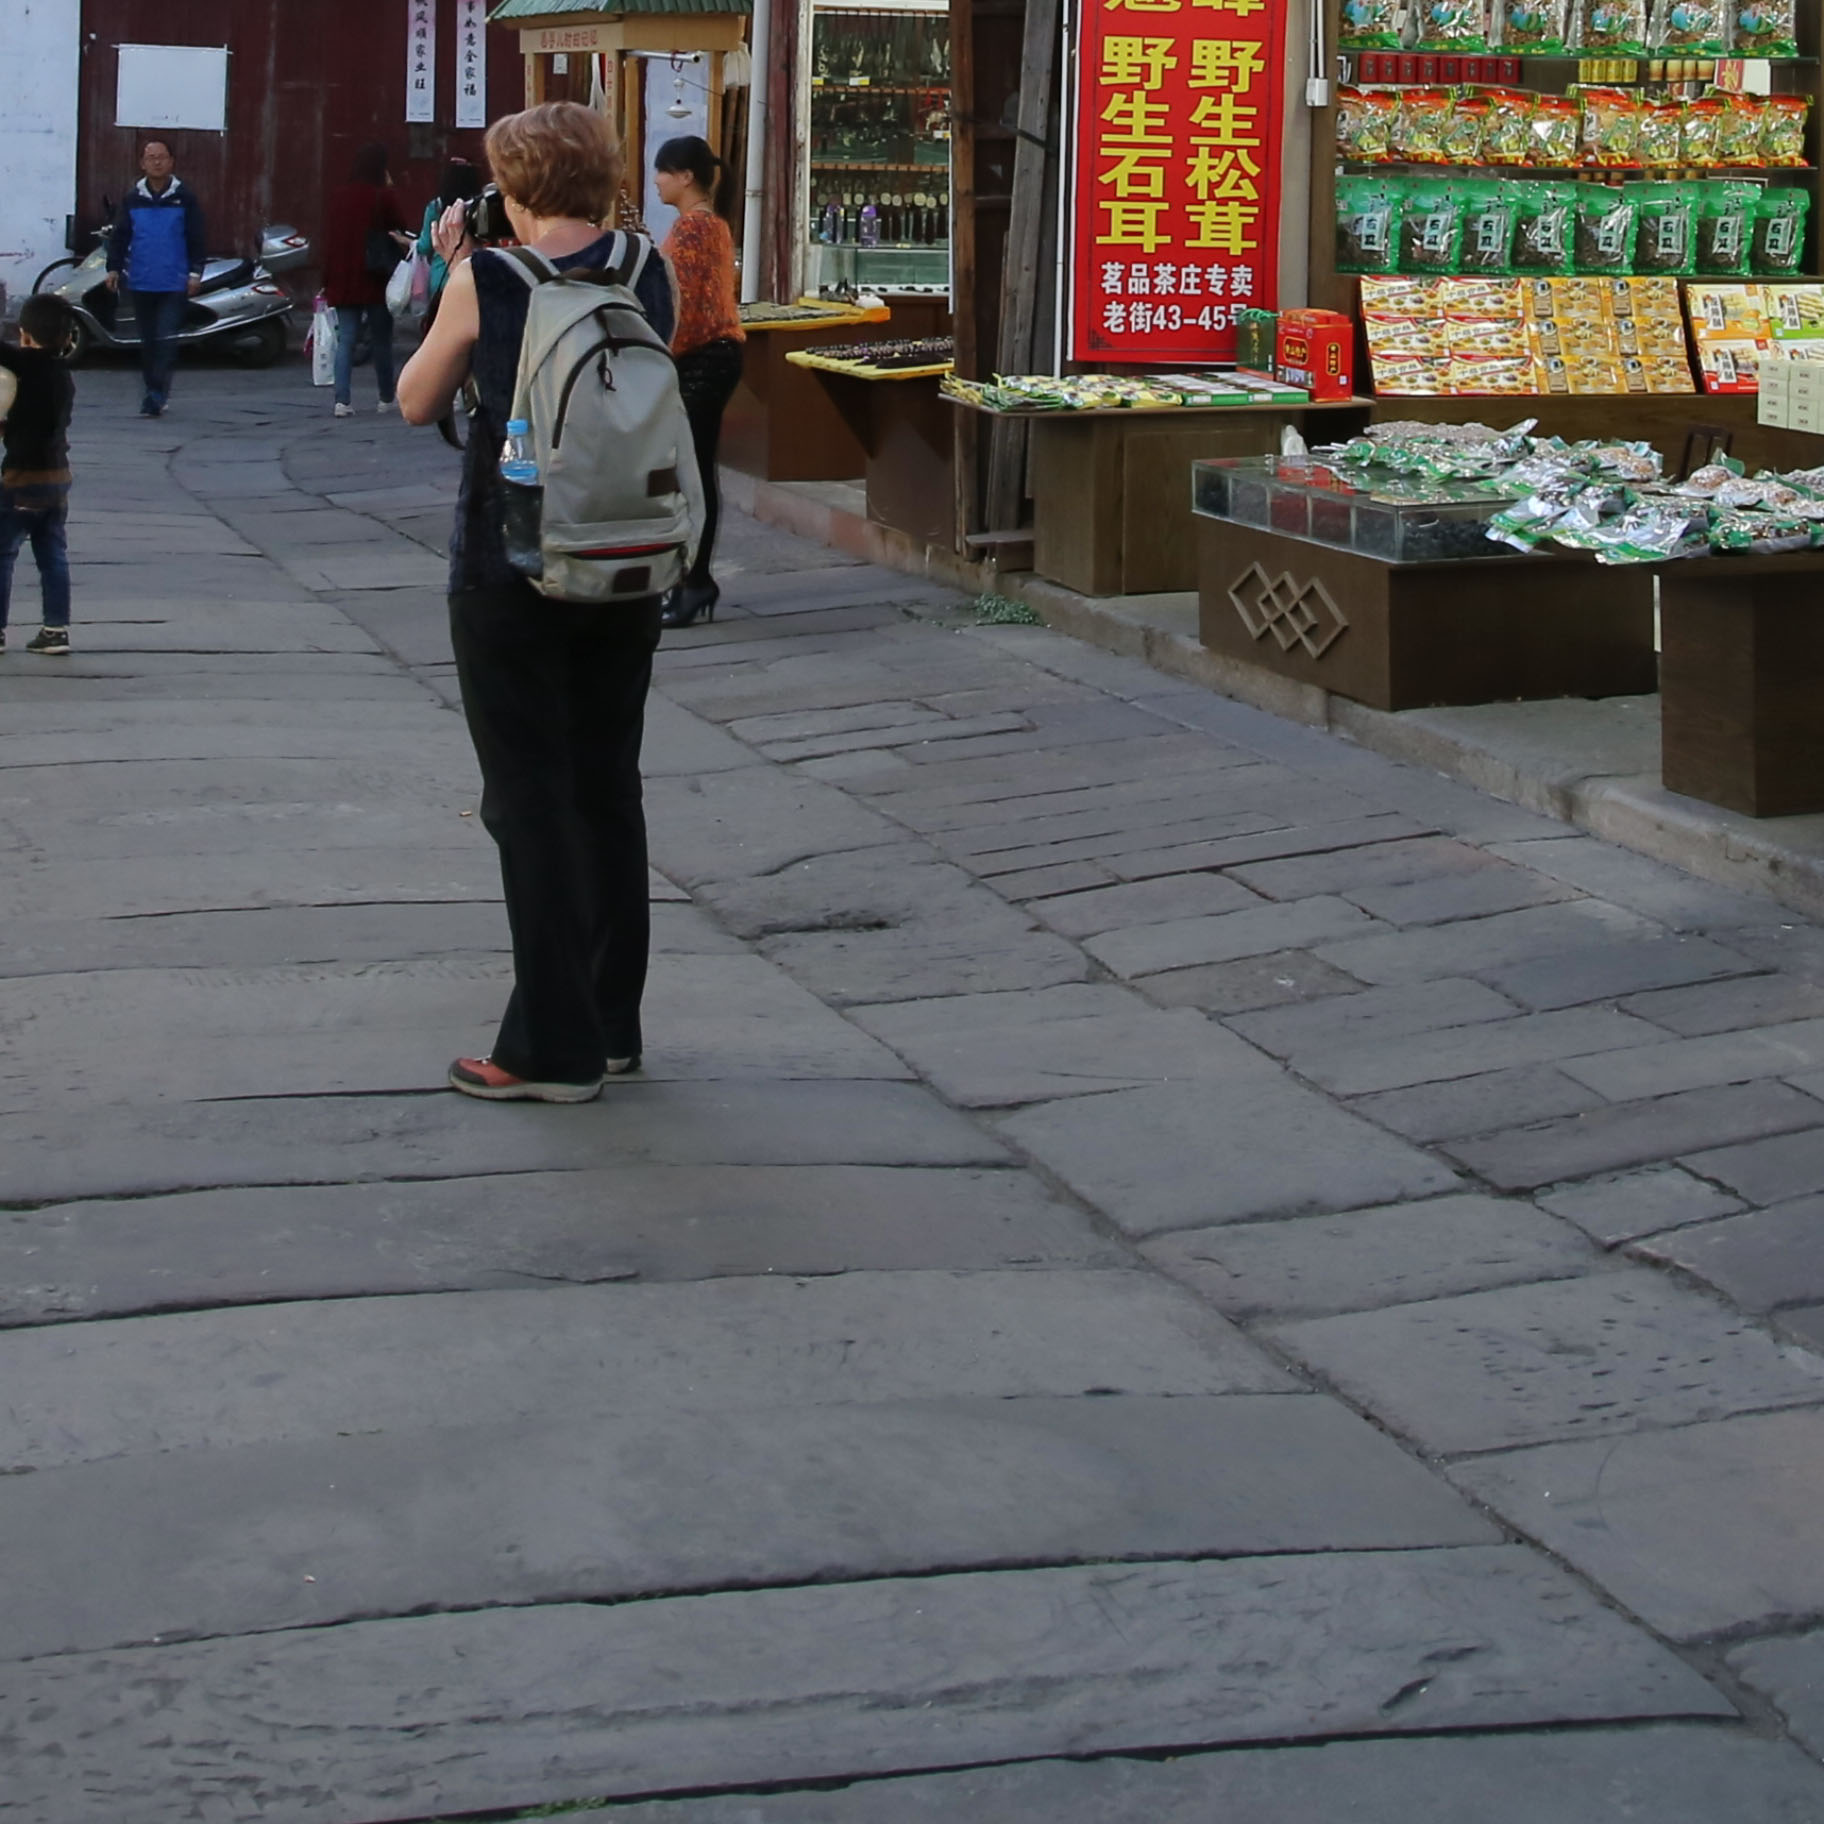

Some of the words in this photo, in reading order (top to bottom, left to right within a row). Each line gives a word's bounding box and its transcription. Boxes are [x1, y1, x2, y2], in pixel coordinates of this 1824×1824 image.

[1096, 36, 1177, 253] 野生石耳
[1185, 38, 1265, 255] 野生松茸
[1101, 262, 1253, 296] 茗品茶庄专卖
